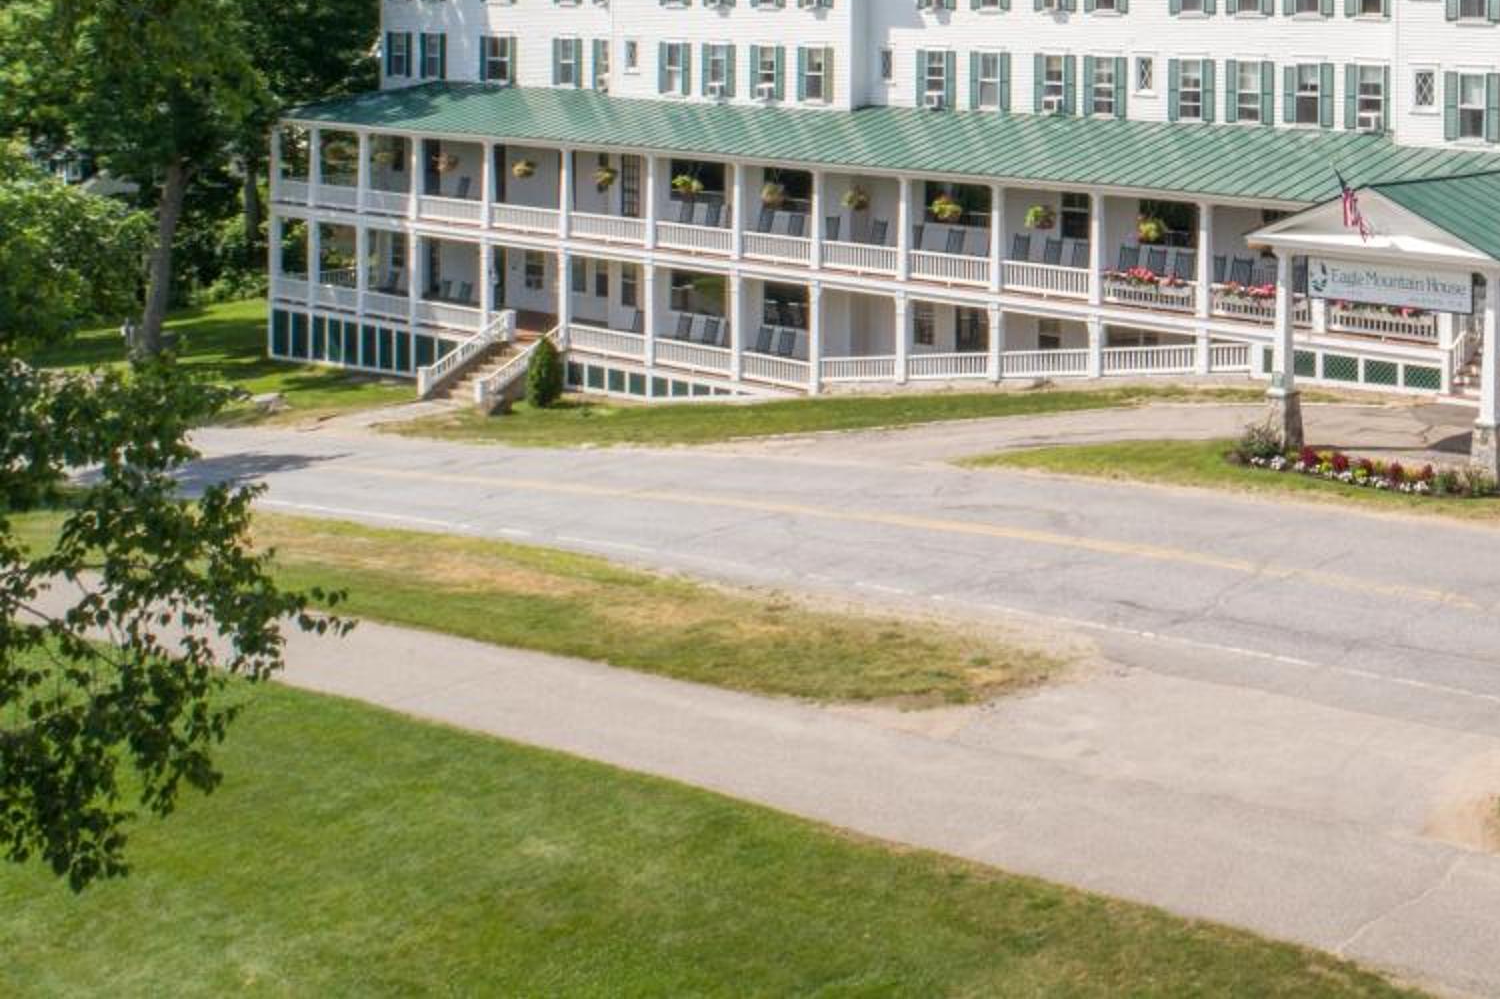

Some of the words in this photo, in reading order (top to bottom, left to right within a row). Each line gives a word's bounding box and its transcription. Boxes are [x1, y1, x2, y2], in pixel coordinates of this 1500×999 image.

[1330, 267, 1362, 286] Eagle
[1363, 270, 1423, 291] Mountain
[1424, 276, 1467, 296] House
